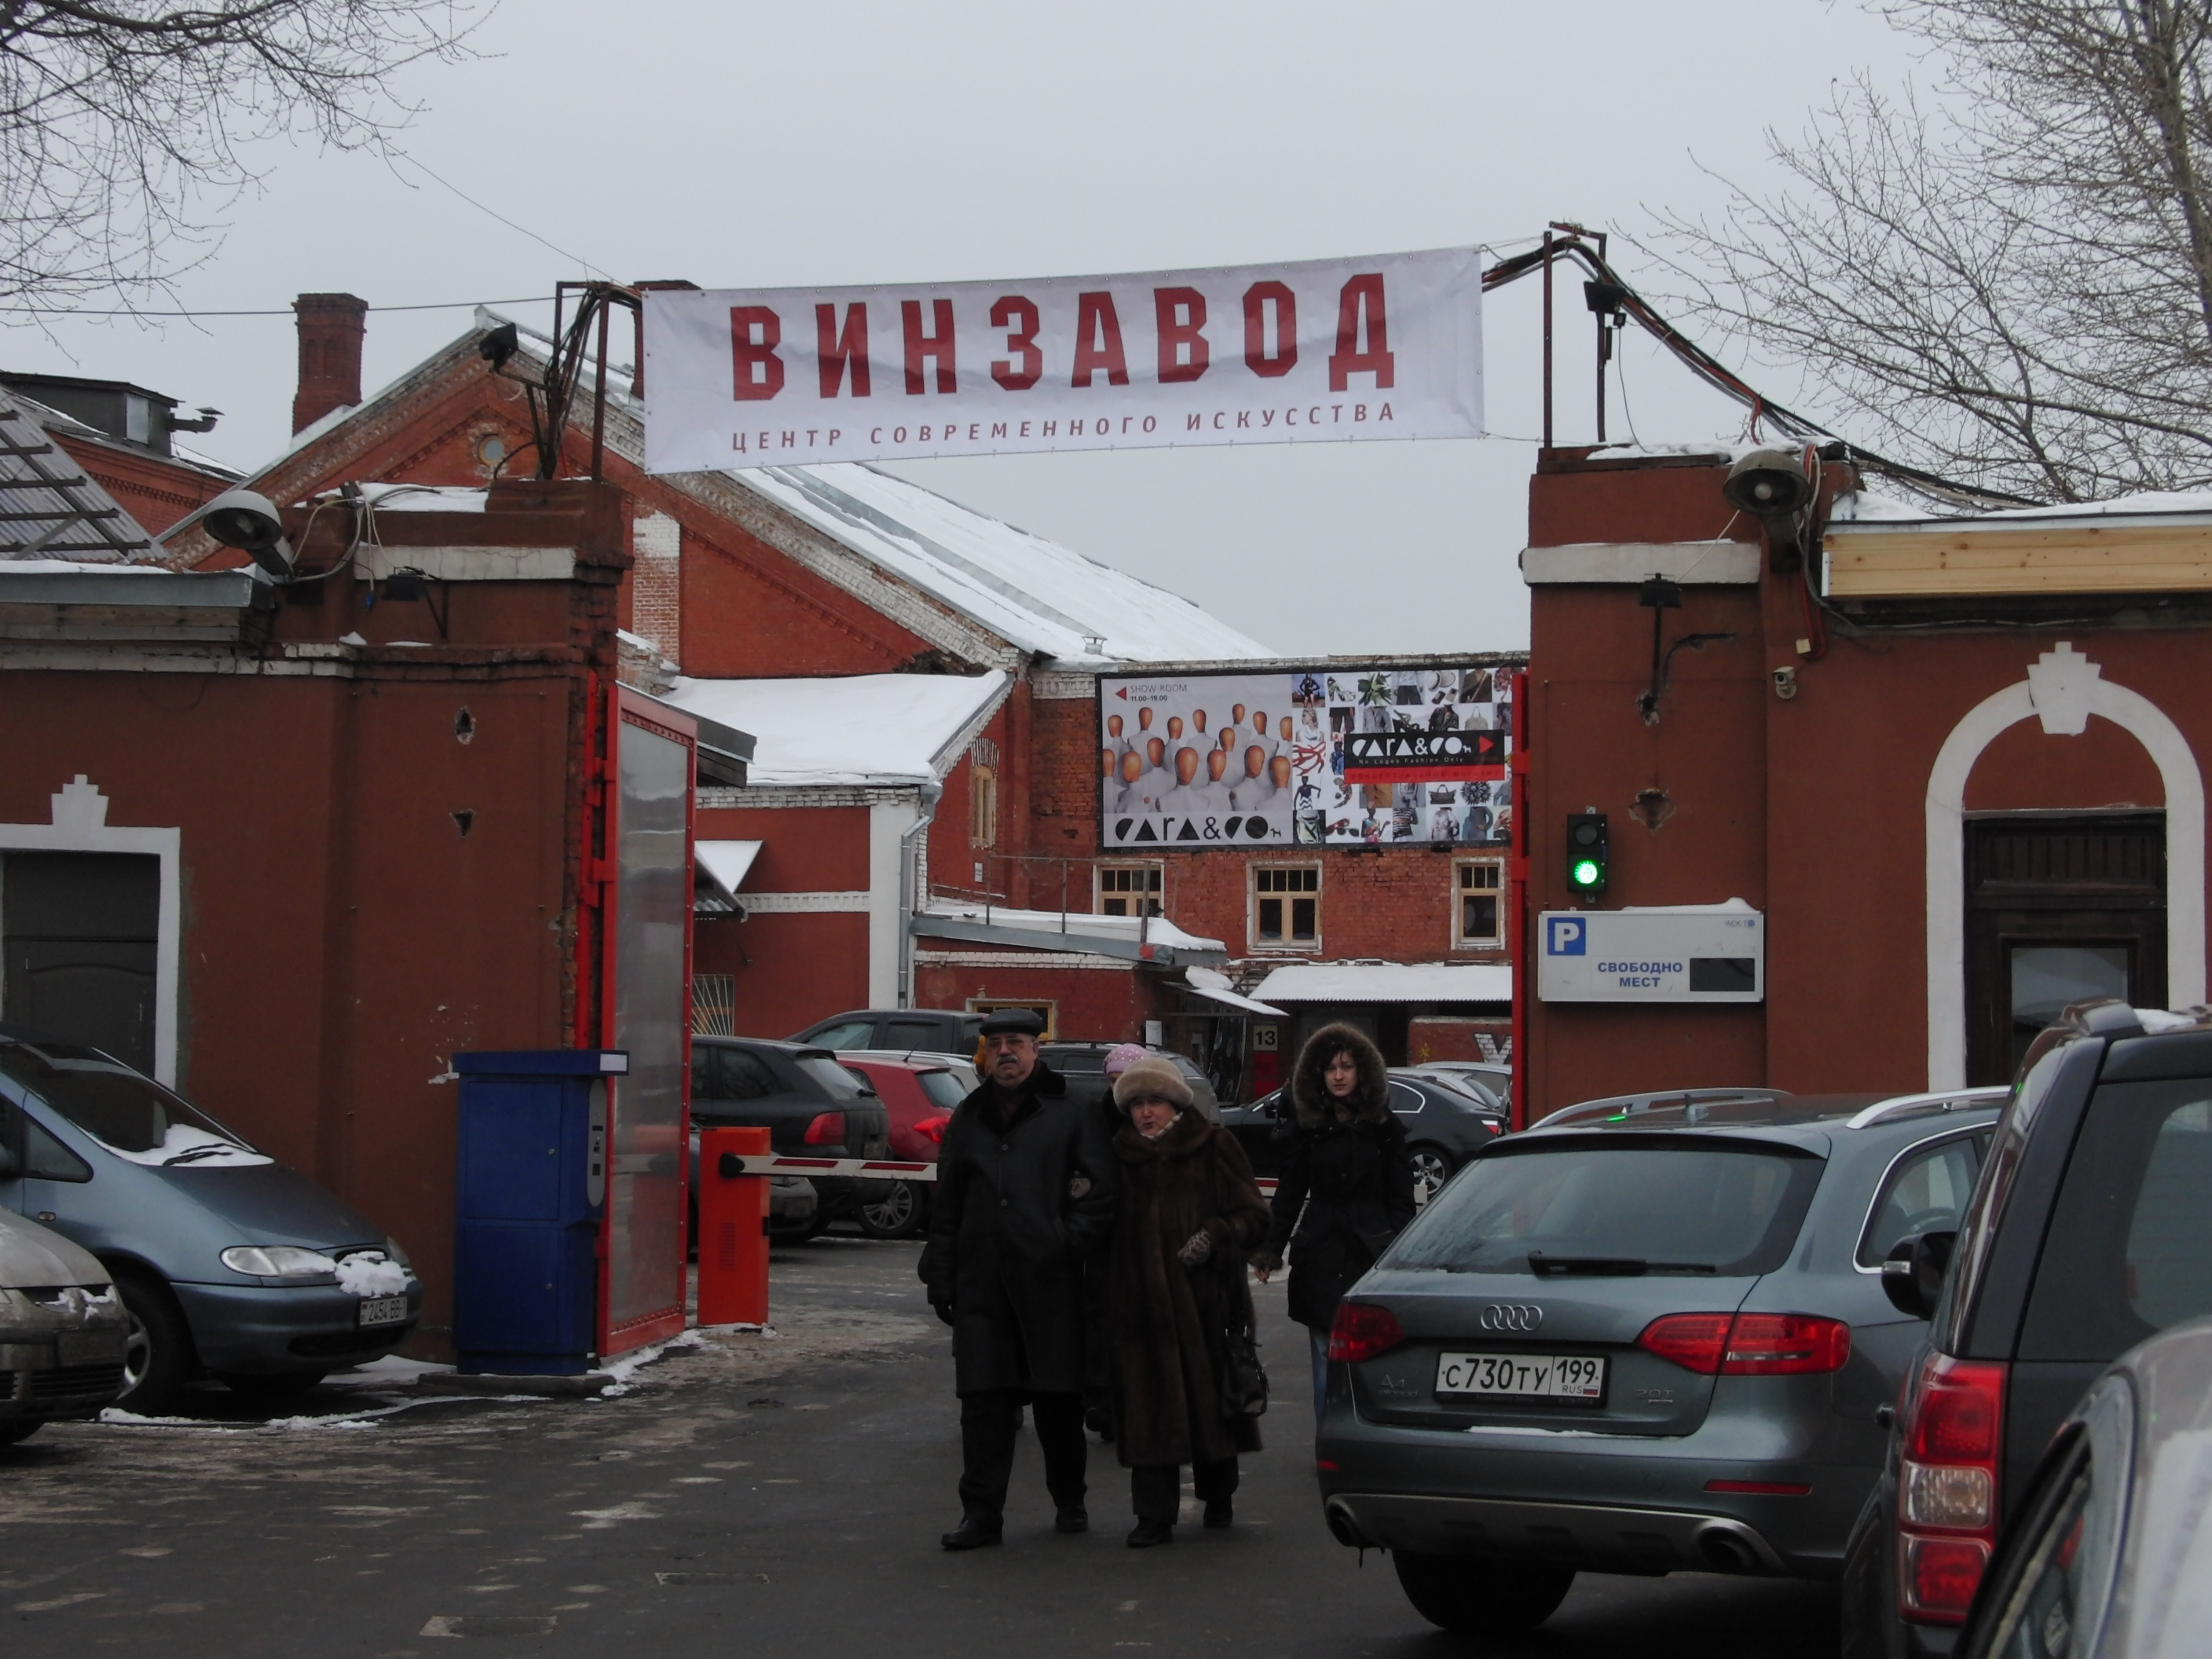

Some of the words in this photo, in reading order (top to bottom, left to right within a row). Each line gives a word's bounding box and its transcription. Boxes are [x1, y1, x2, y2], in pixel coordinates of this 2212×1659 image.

[730, 273, 1395, 402] ВИНЗАВОД
[731, 429, 844, 455] ЦЕНТР
[869, 415, 1158, 445] СОВРЕМЕННОГО
[1187, 403, 1394, 430] ИСКУССТВА
[1130, 684, 1187, 693] SHOW-ROOM
[1598, 962, 1683, 973] СВОБОДНО
[1619, 978, 1660, 987] МЕСТ
[1256, 1031, 1276, 1046] 13
[1556, 1359, 1596, 1384] 199
[1562, 1385, 1583, 1393] RUS
